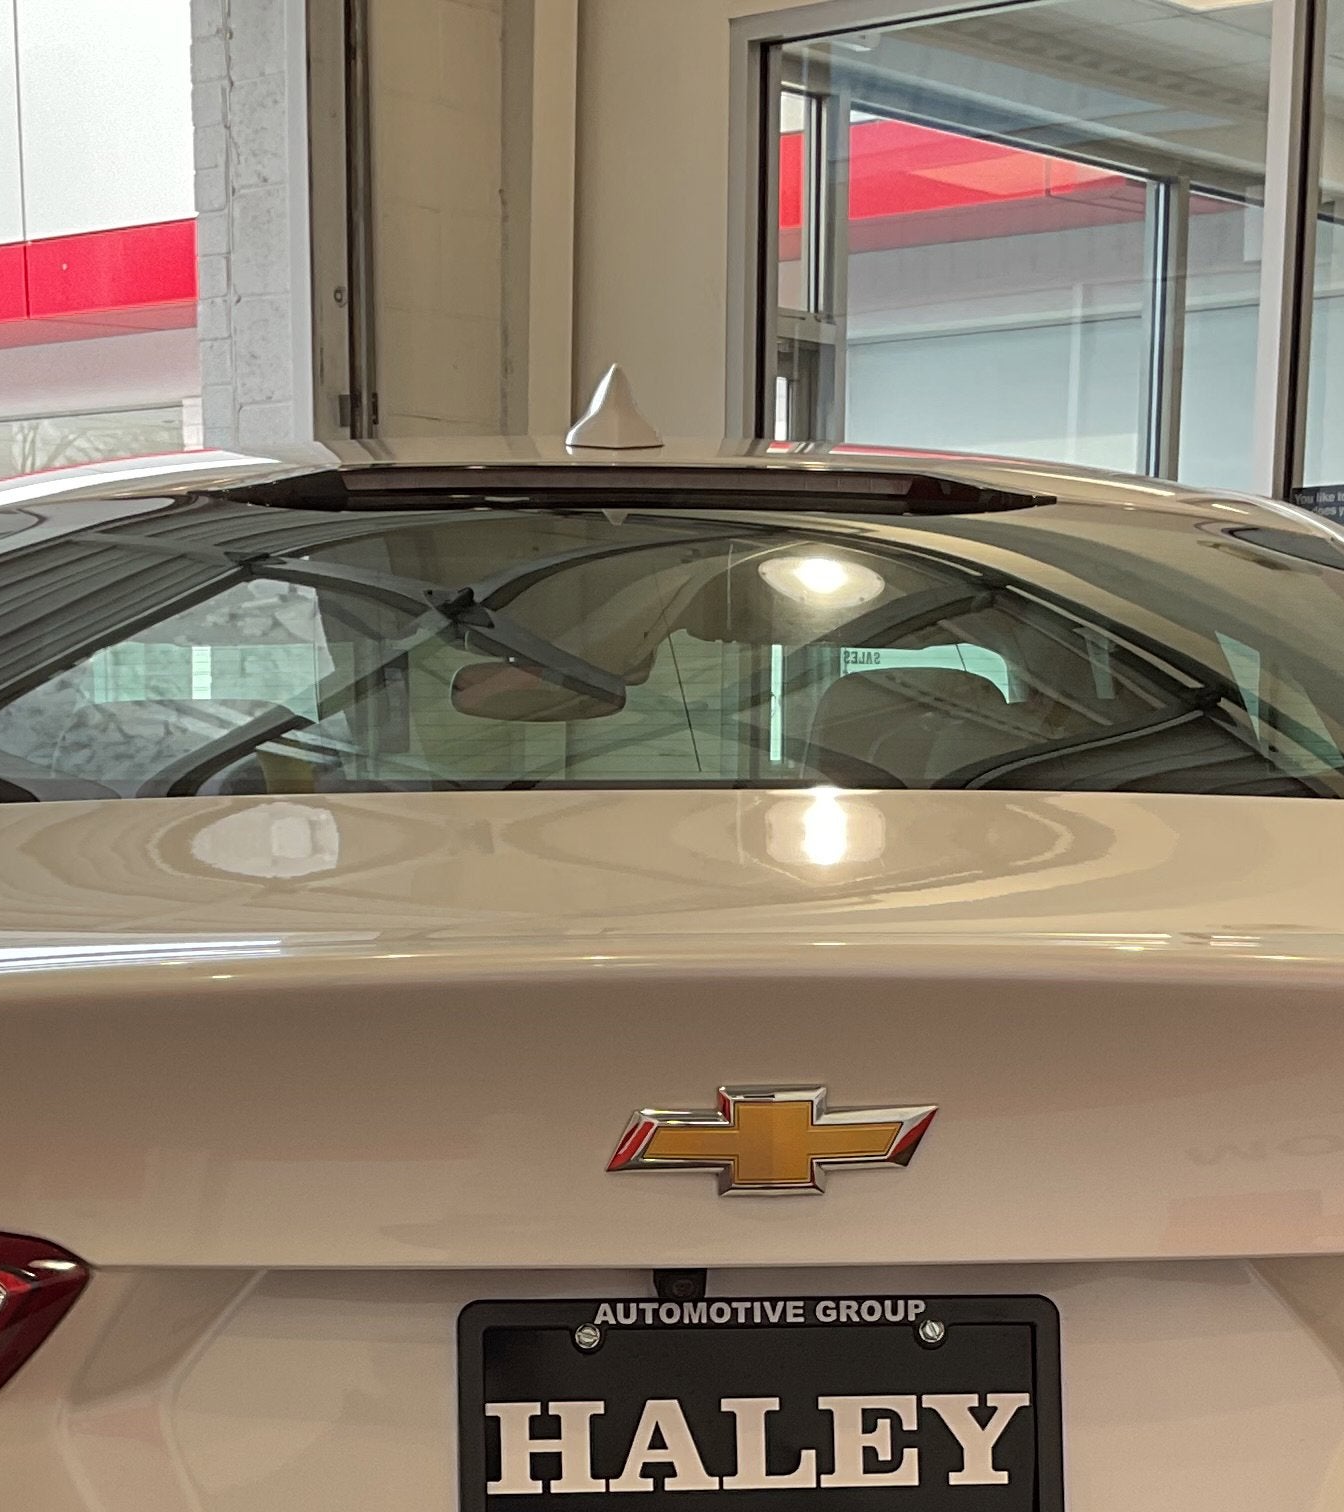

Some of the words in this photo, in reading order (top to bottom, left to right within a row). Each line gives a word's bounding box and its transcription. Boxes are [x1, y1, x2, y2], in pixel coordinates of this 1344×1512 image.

[1294, 493, 1313, 505] You
[1316, 491, 1335, 503] like
[593, 1300, 805, 1325] AUTOMOTIVE
[814, 1299, 927, 1323] GROUP
[485, 1392, 1031, 1496] HALEY
